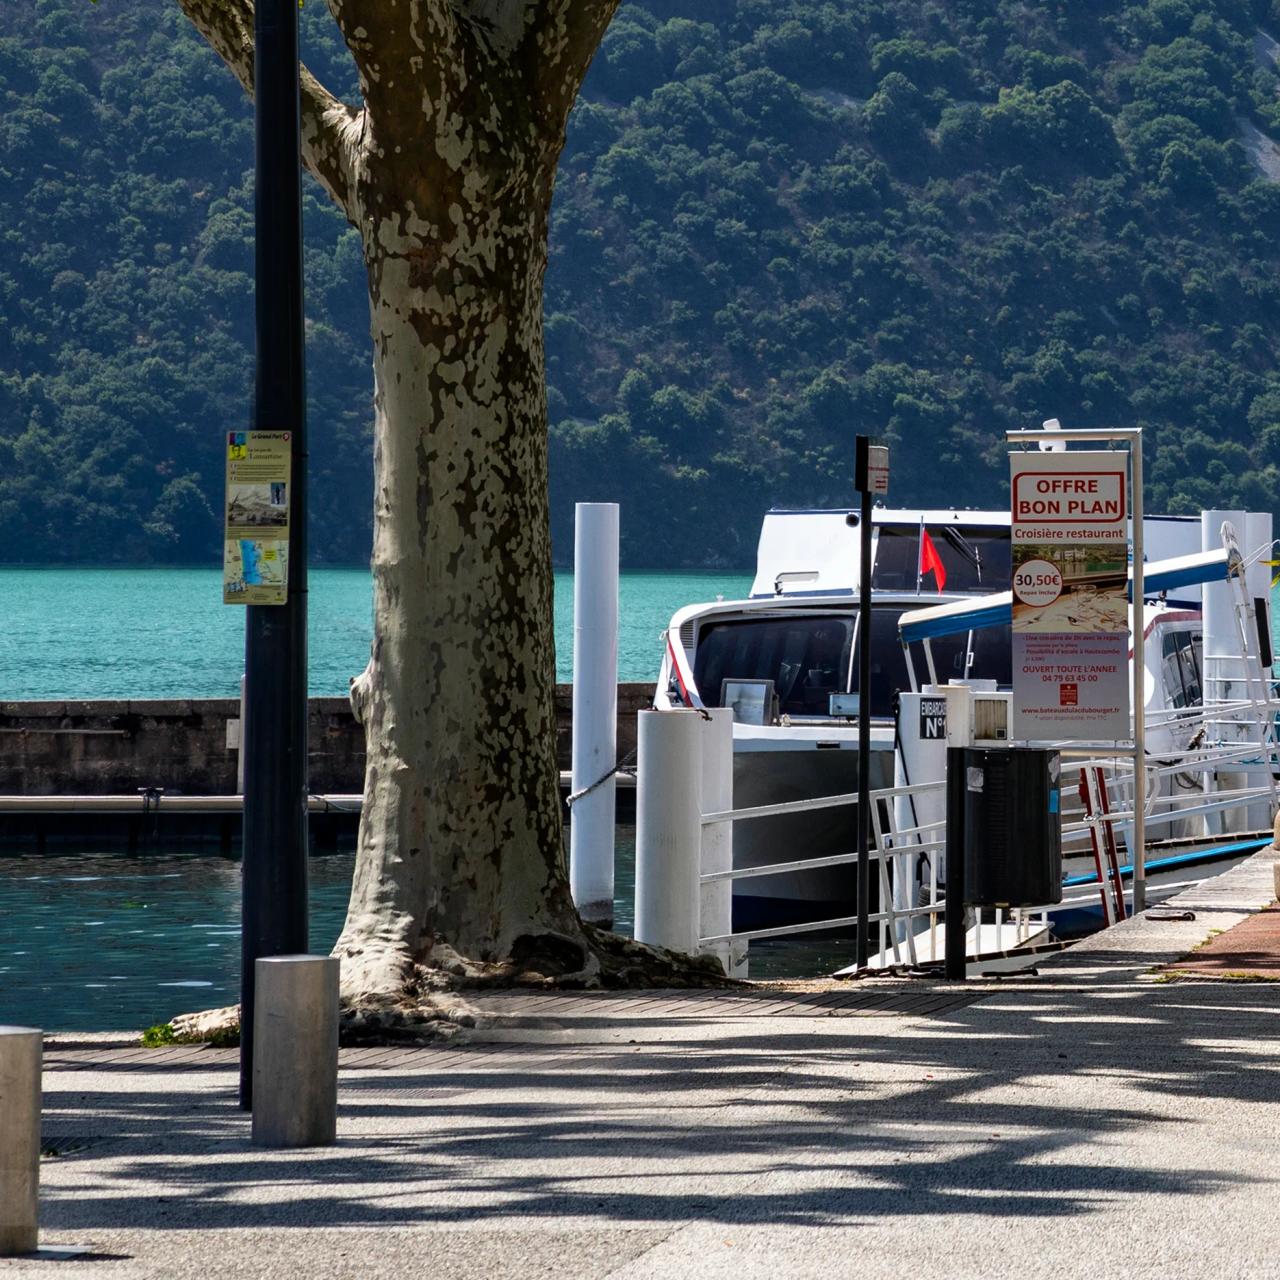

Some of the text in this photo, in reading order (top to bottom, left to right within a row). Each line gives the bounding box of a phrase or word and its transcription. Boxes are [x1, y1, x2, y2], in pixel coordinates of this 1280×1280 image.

[1037, 480, 1098, 493] OFFRE
[1020, 501, 1118, 514] BON PLAN
[1015, 528, 1124, 538] Croisière restaurant
[1015, 574, 1060, 587] 30,50€
